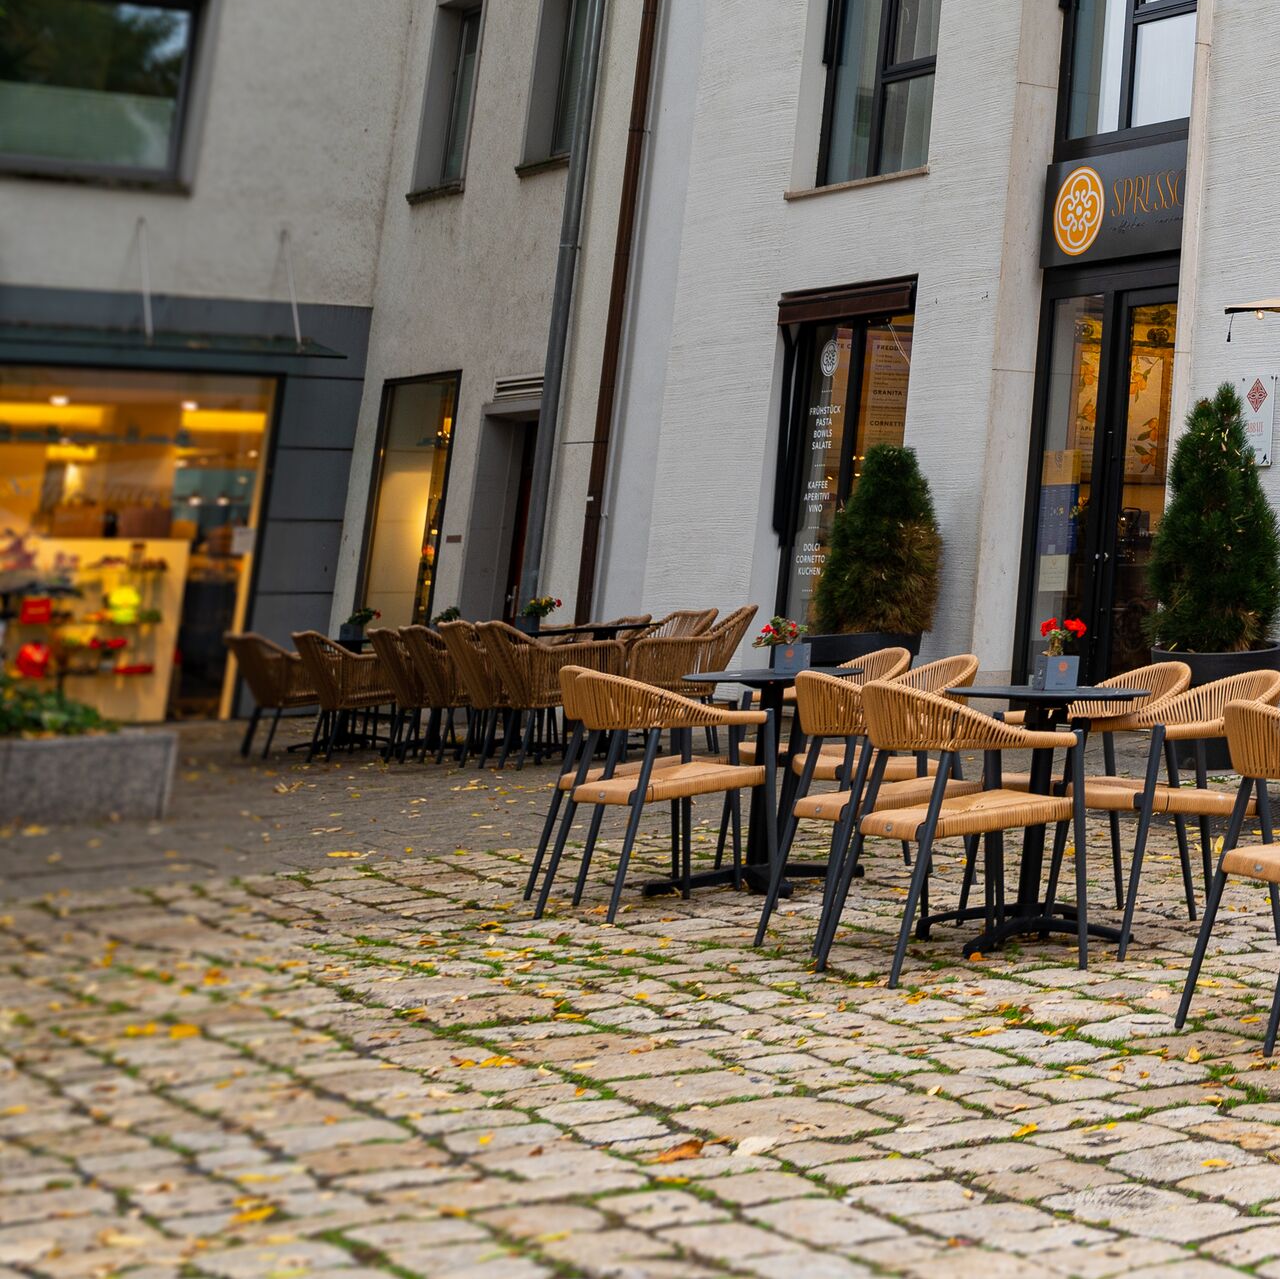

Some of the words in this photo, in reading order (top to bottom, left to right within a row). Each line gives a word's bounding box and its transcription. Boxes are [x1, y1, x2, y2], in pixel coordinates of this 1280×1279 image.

[809, 404, 842, 416] FRÜHSTÜCK
[815, 417, 833, 427] PASTA
[813, 428, 833, 439] BOWLS
[812, 439, 832, 451] SALATE
[807, 480, 829, 490] KAFFEE
[804, 492, 830, 503] APERITIVI
[808, 503, 823, 514] VINO
[803, 543, 821, 553] DOLCI
[796, 554, 825, 565] CORNETTO
[798, 565, 821, 576] KUCHEN
